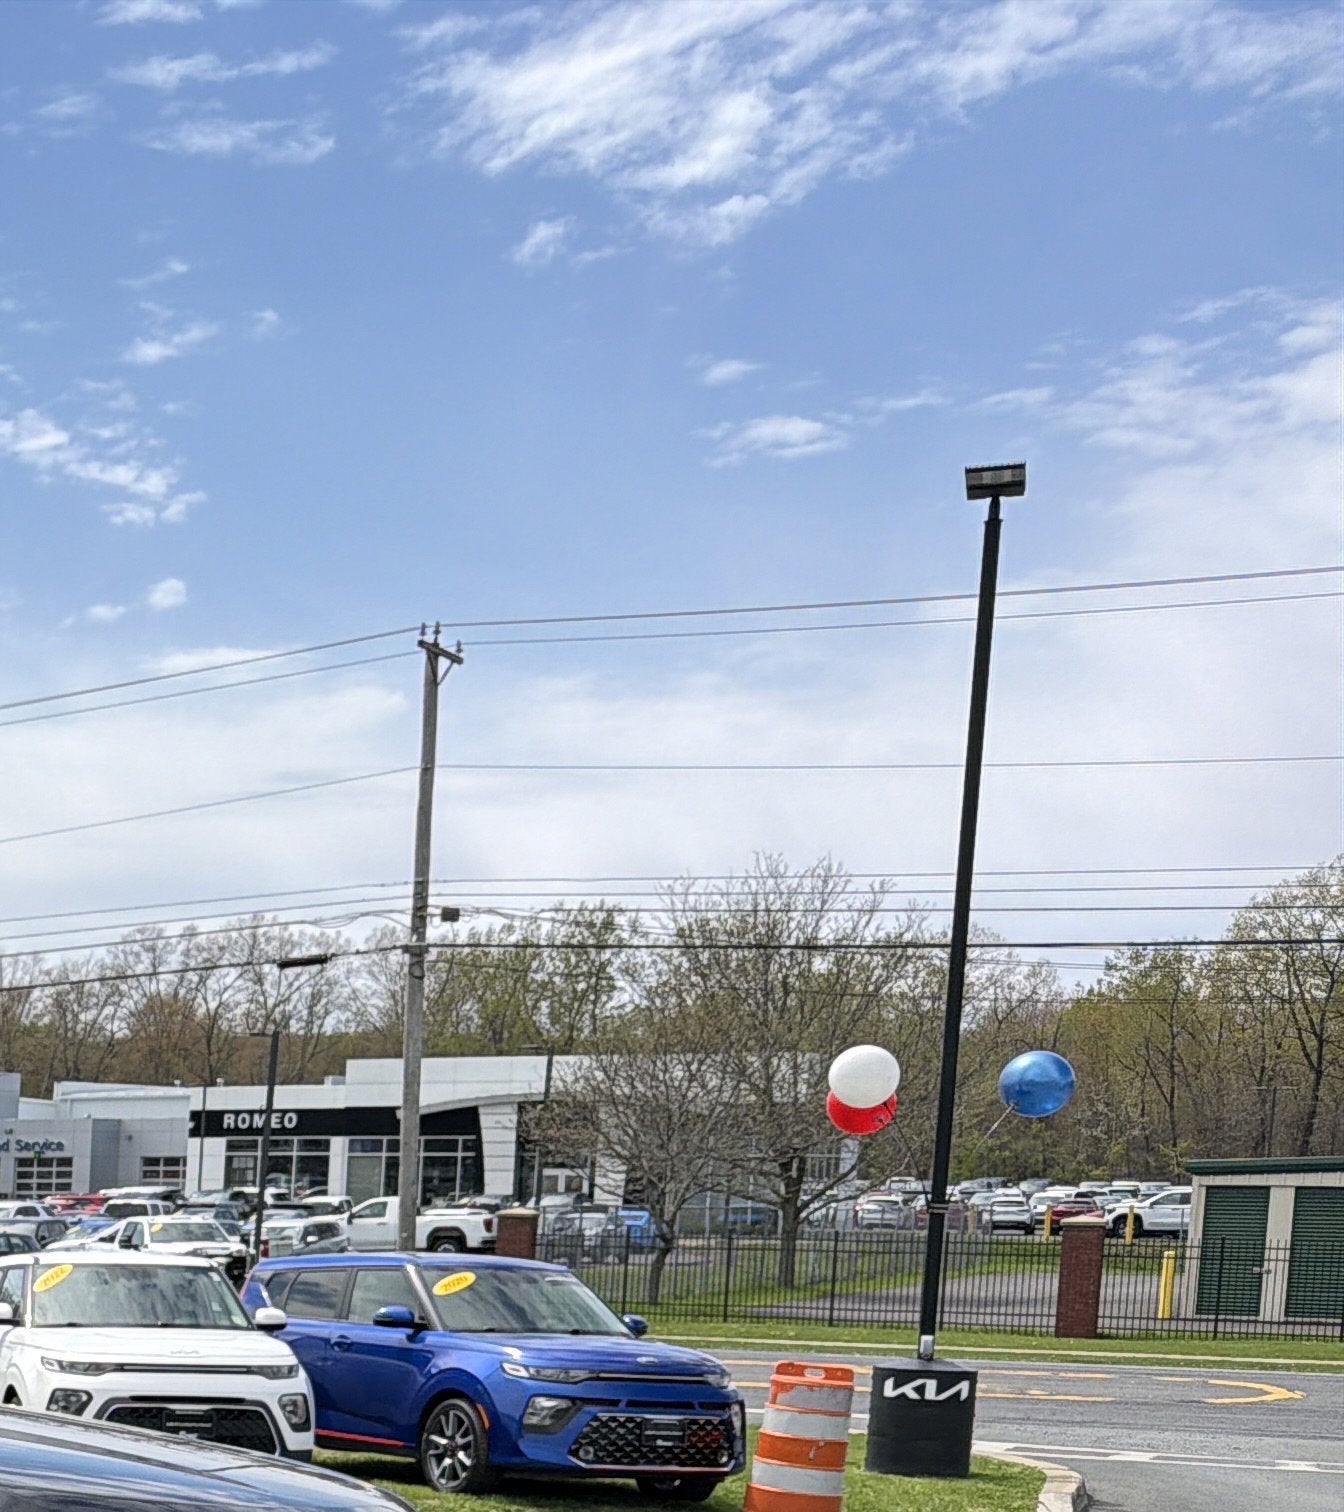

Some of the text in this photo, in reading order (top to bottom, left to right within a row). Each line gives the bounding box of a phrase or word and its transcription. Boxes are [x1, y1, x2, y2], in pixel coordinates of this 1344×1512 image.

[223, 1112, 298, 1130] ROMEO
[15, 1139, 65, 1152] Service
[883, 1376, 970, 1402] KIA
